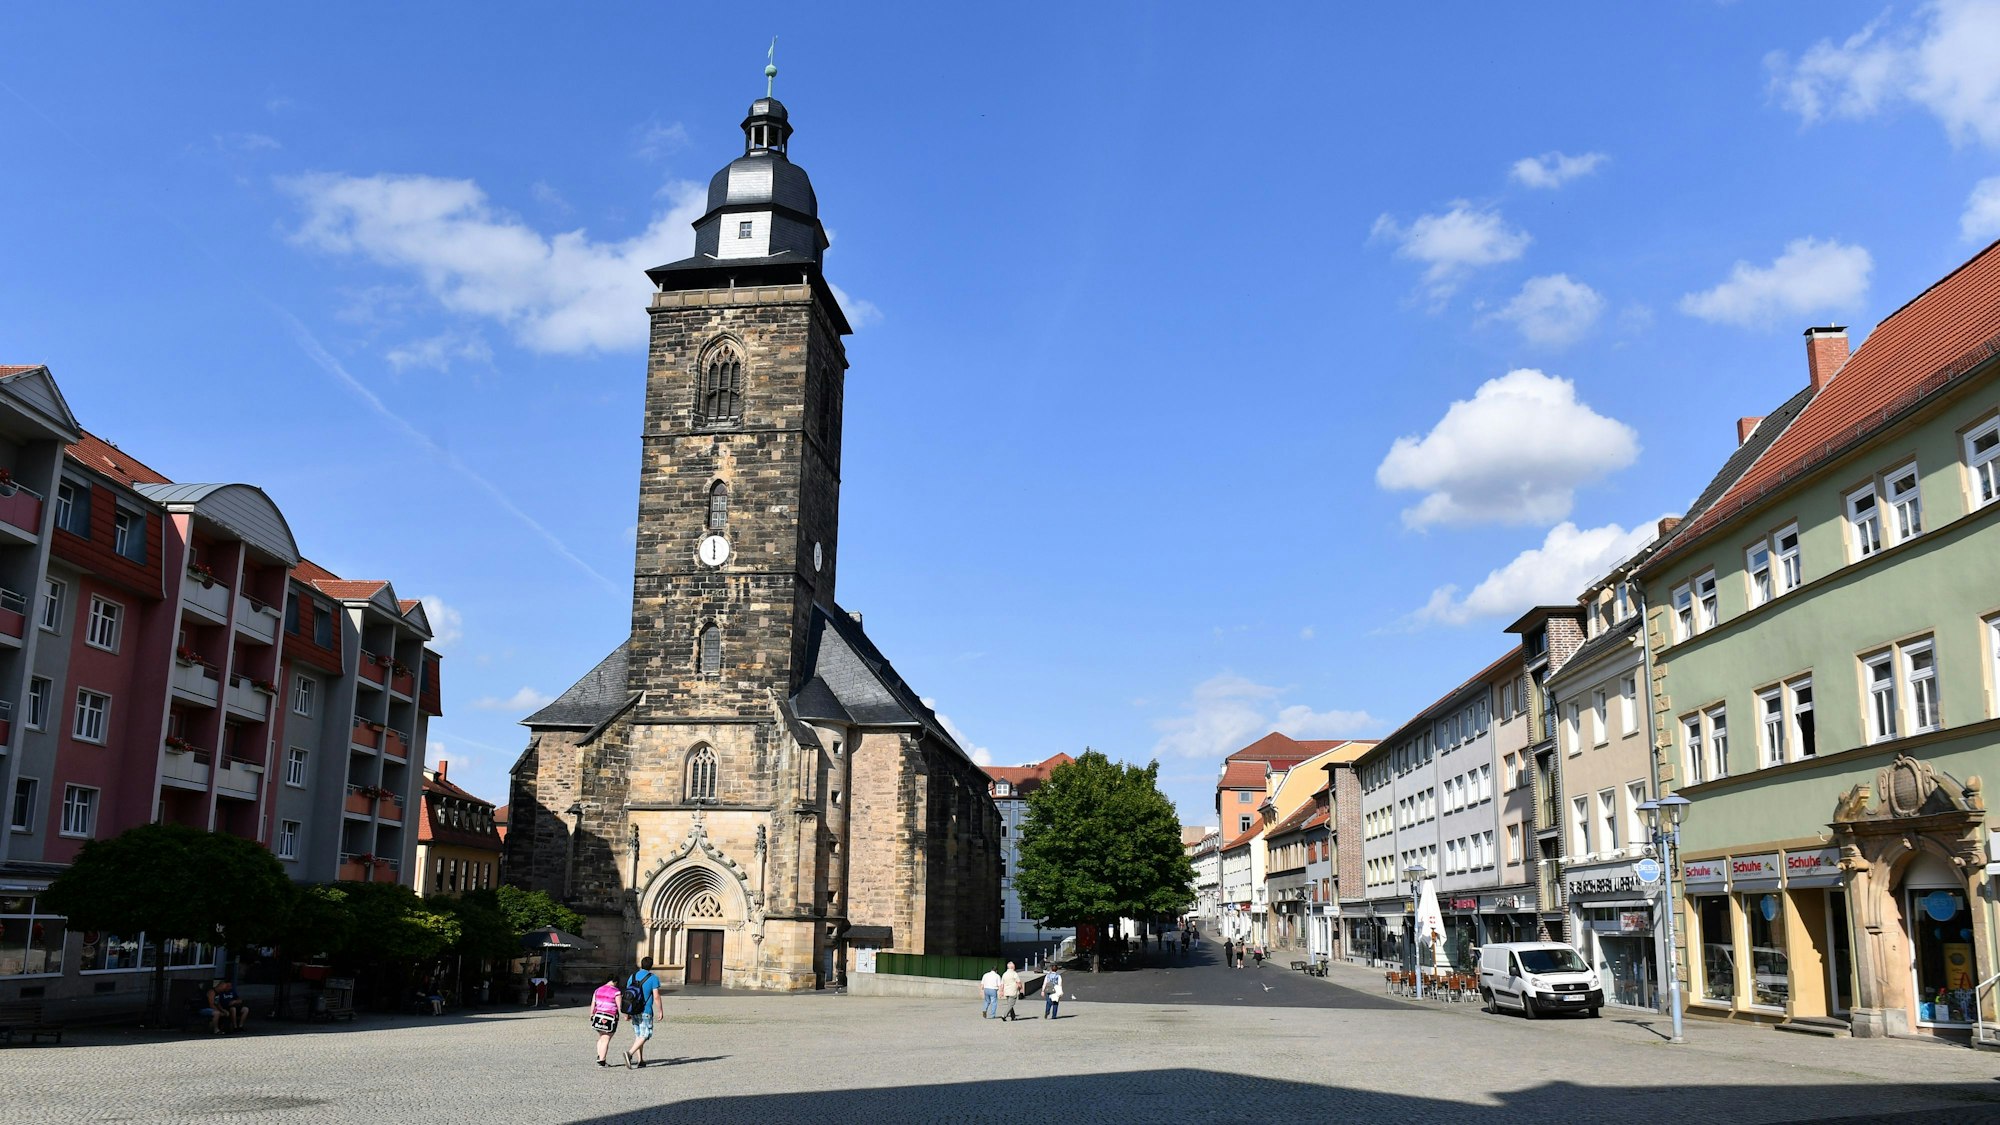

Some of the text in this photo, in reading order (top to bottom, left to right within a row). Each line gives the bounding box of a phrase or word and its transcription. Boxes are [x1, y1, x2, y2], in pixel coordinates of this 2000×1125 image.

[1733, 861, 1762, 873] Schuhe
[1788, 856, 1821, 869] Schuhe
[1686, 866, 1711, 877] Schuhe
